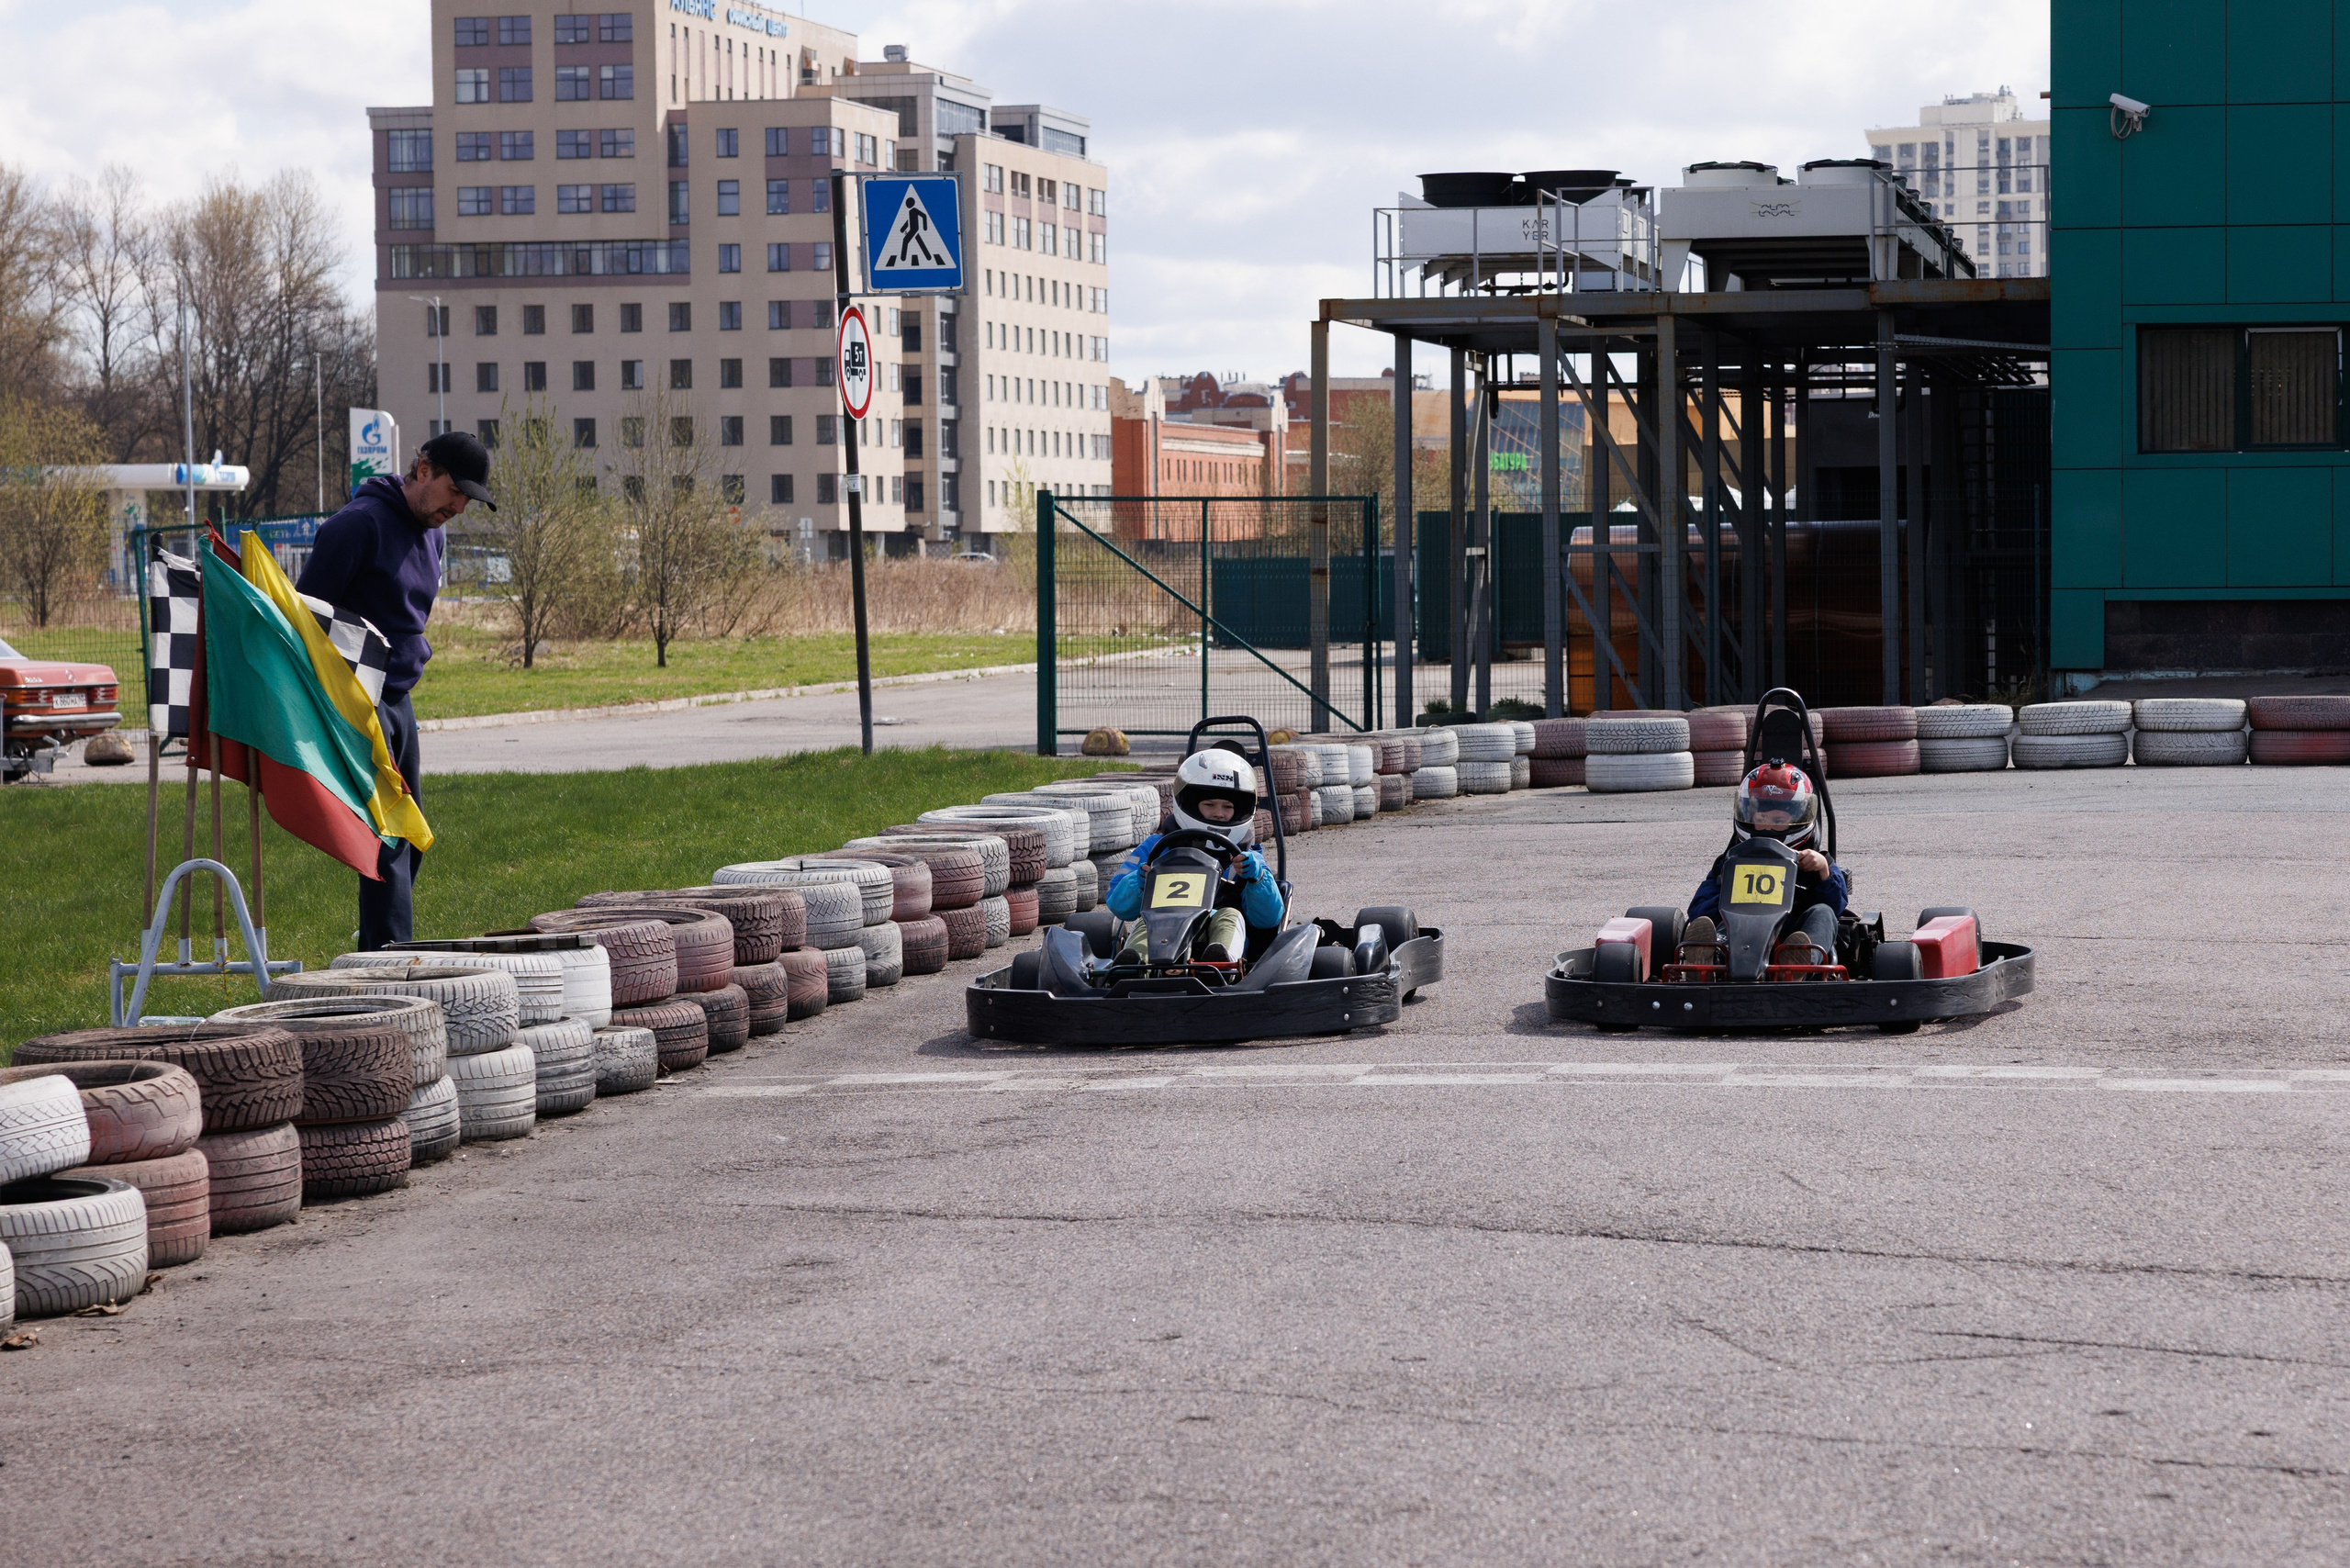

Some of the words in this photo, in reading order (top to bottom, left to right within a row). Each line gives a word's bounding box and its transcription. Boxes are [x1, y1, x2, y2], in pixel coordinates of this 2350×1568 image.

[1522, 218, 1549, 230] KAR
[1522, 230, 1549, 241] YER
[1166, 881, 1191, 899] 2
[1744, 874, 1775, 895] 10
